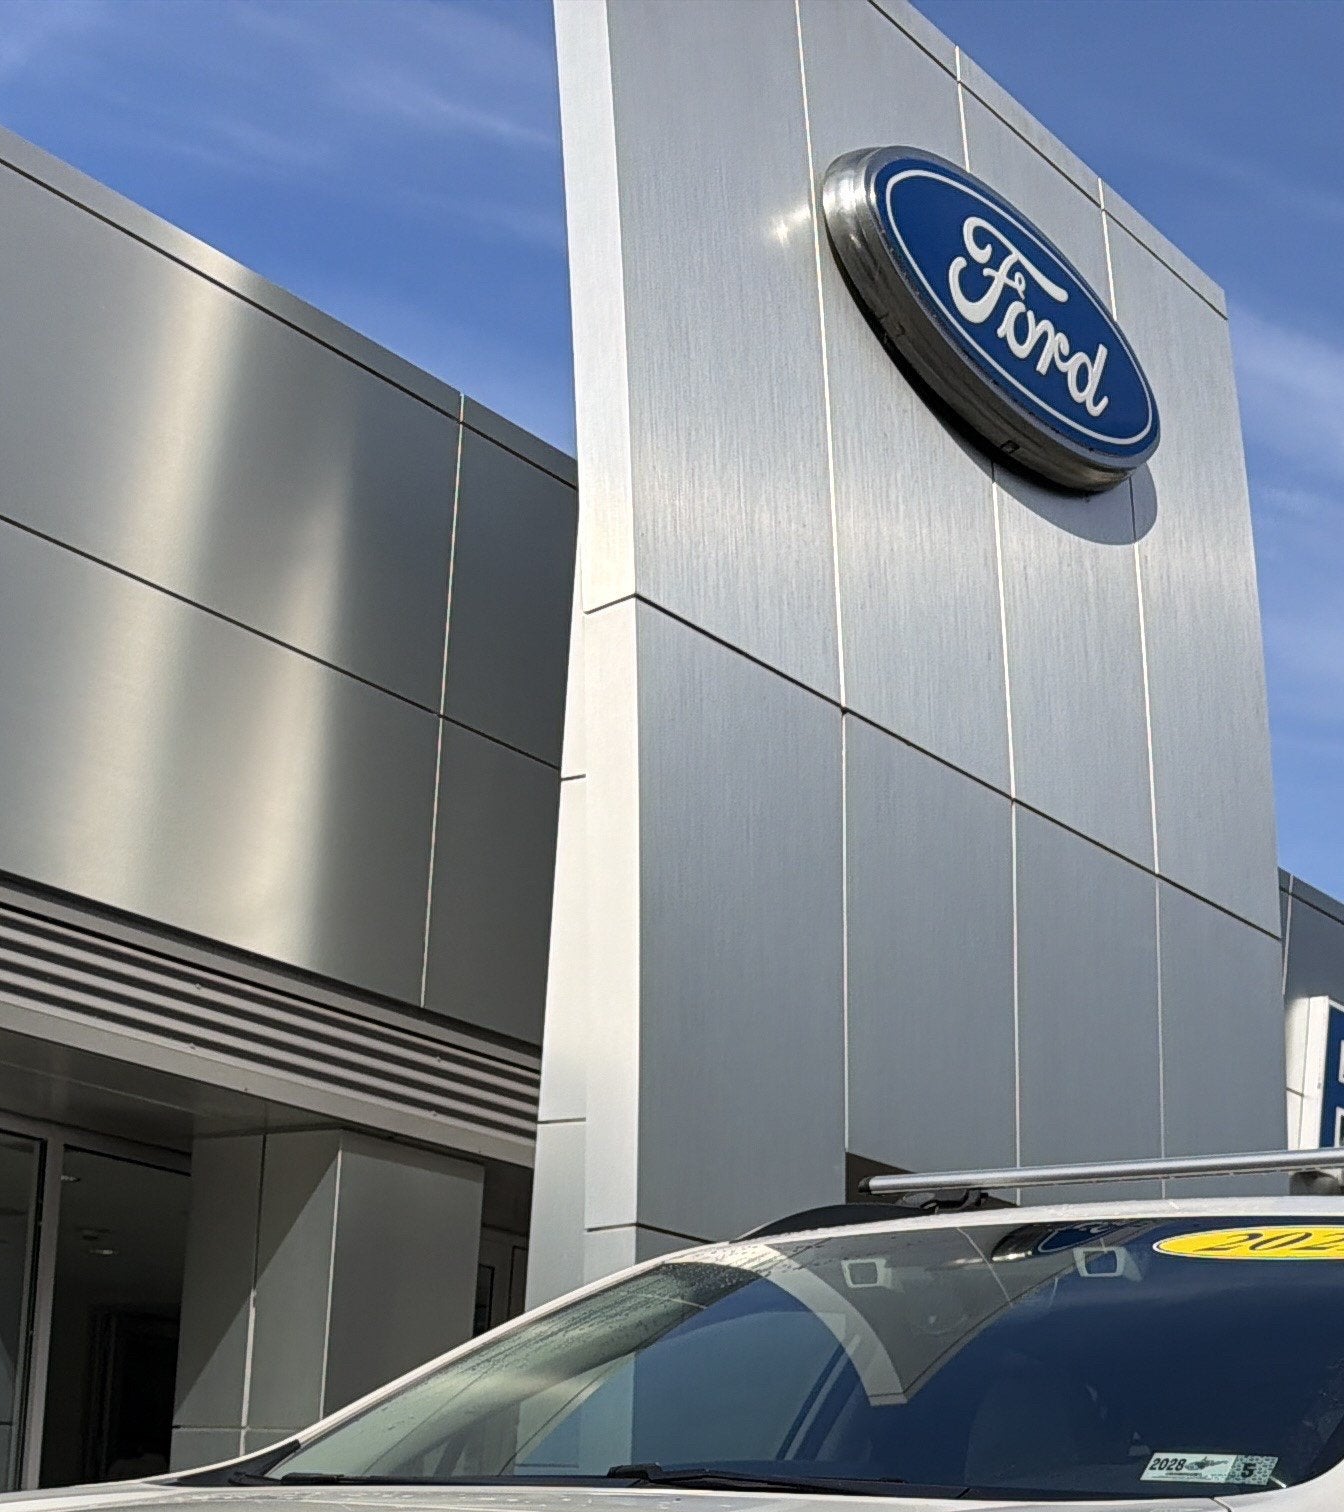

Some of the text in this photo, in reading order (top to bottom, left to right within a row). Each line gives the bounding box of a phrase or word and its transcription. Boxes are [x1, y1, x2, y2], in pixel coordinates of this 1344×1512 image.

[949, 216, 1109, 417] Ford
[1149, 1458, 1257, 1478] 2028 5
